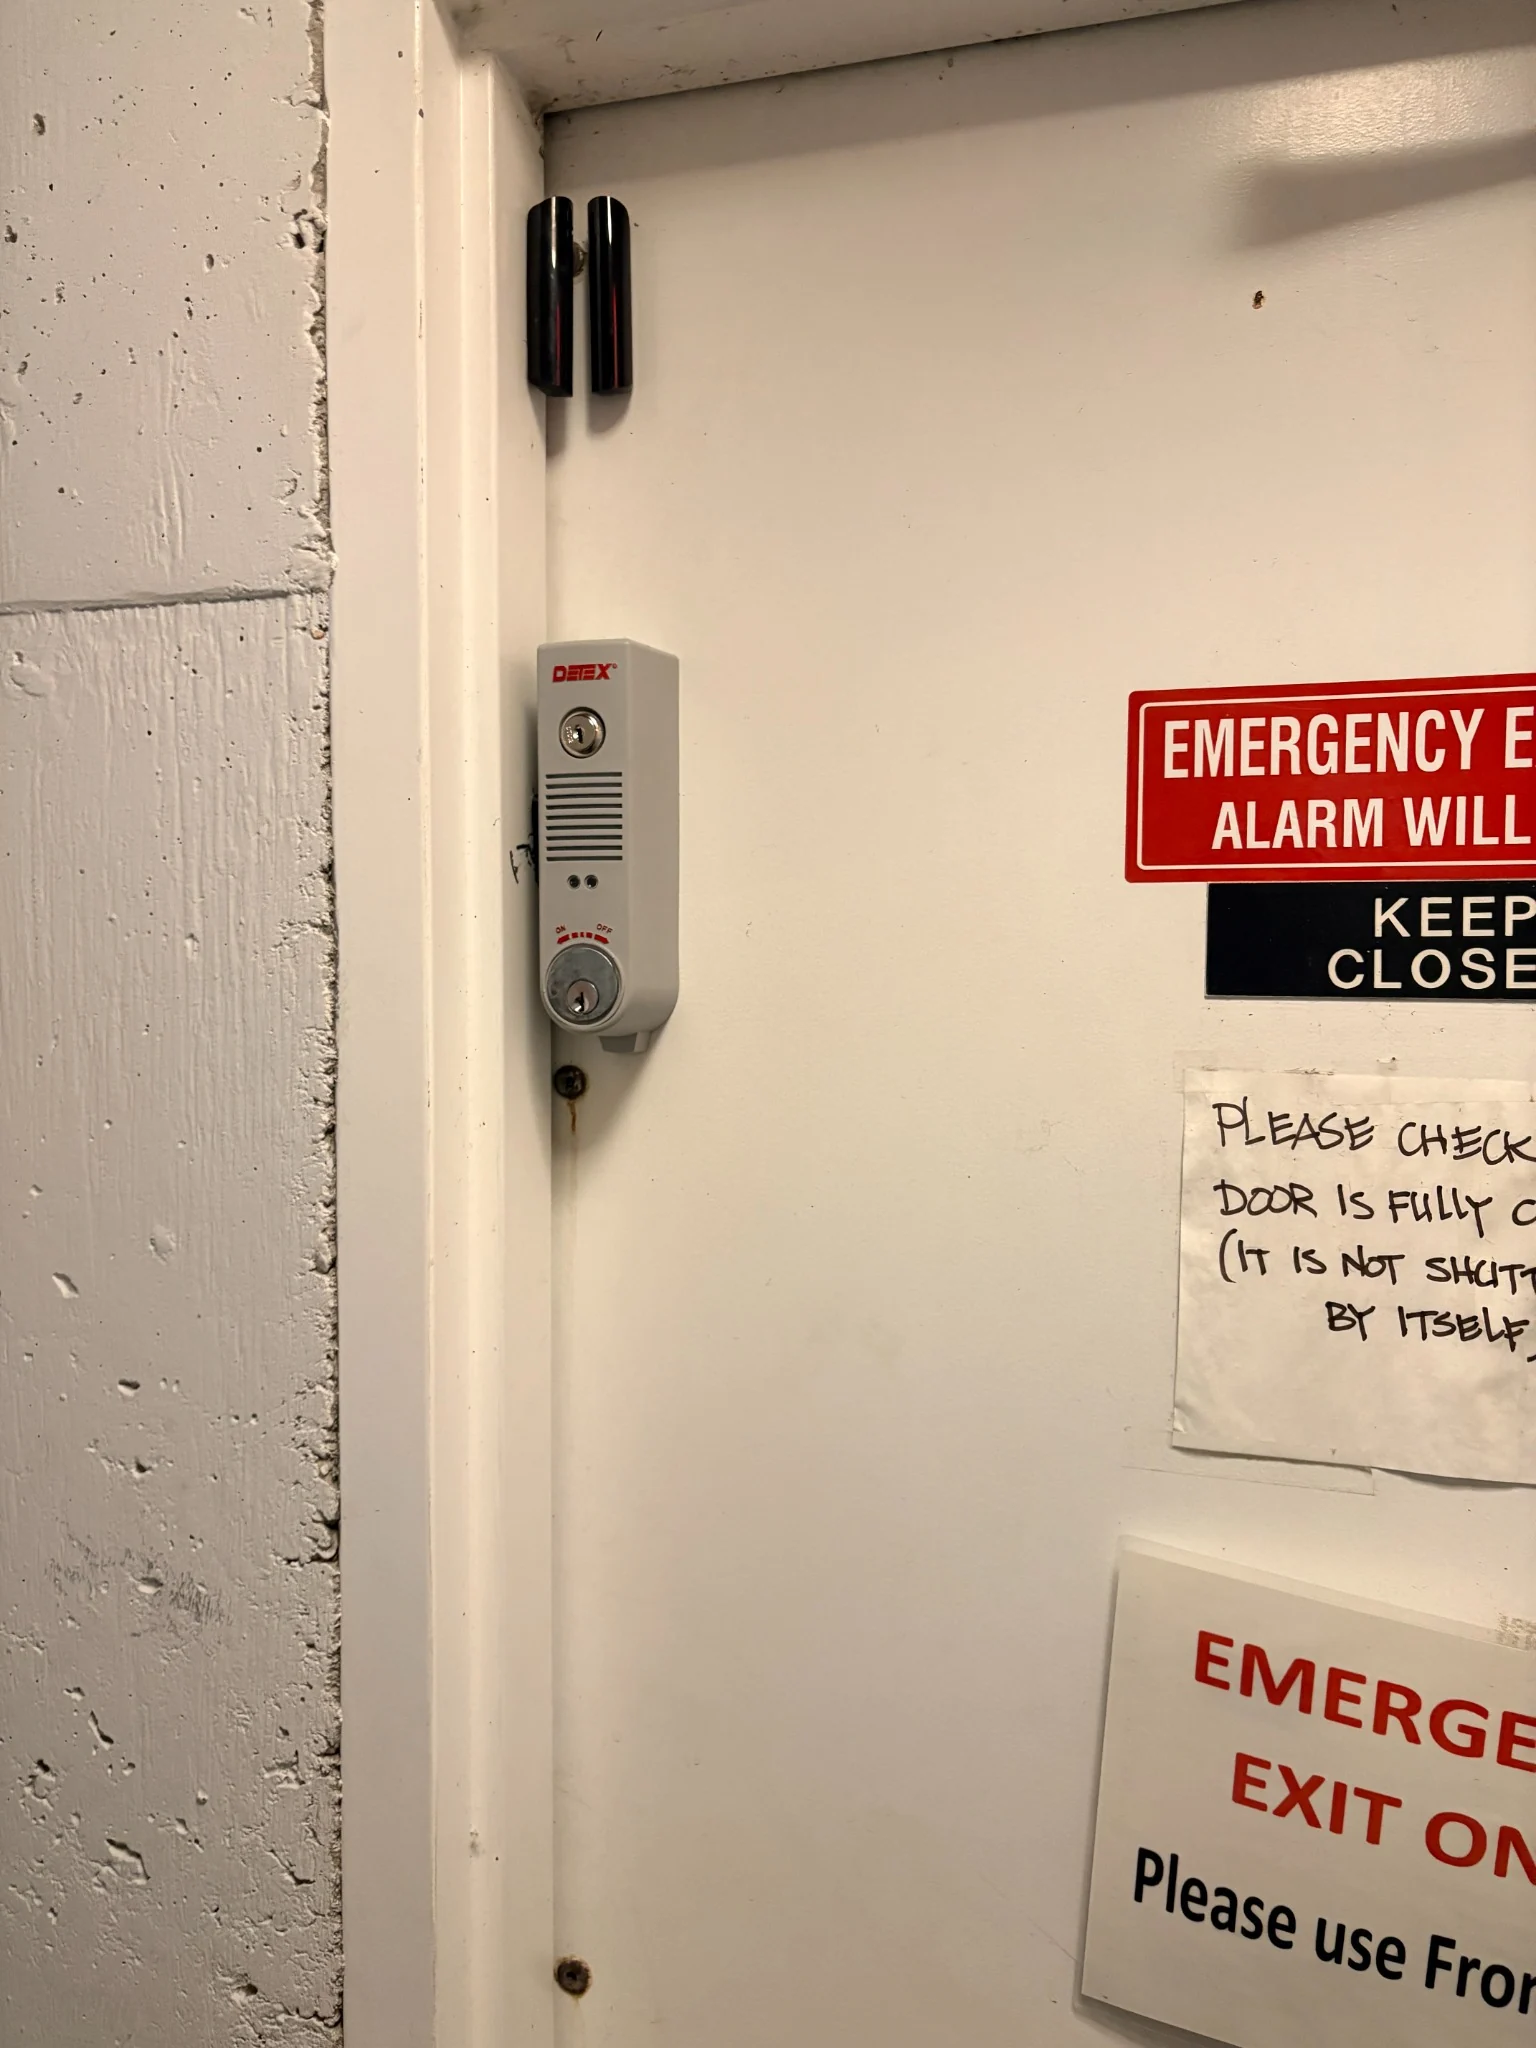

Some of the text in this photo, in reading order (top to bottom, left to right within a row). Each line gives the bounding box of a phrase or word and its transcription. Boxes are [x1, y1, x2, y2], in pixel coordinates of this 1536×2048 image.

[552, 663, 613, 683] DETEX
[1164, 706, 1536, 779] EMERGENCY E
[1212, 794, 1532, 850] ALARM WILL
[555, 924, 567, 934] ON
[596, 923, 614, 934] OFF
[1374, 895, 1536, 938] KEEP
[1328, 947, 1536, 990] CLOSE
[1212, 1096, 1536, 1165] PLEASE CHECK
[1213, 1179, 1318, 1218] DOOR
[1337, 1183, 1375, 1220] IS
[1388, 1185, 1494, 1239] FULLY
[1219, 1228, 1271, 1283] (IT
[1294, 1246, 1328, 1274] IS
[1342, 1245, 1406, 1285] NOT
[1325, 1301, 1536, 1358] BY ITSELF
[1194, 1629, 1536, 1773] EMERGE
[1231, 1752, 1536, 1886] EXIT ON
[1133, 1847, 1297, 1950] Please
[1315, 1917, 1406, 1981] use
